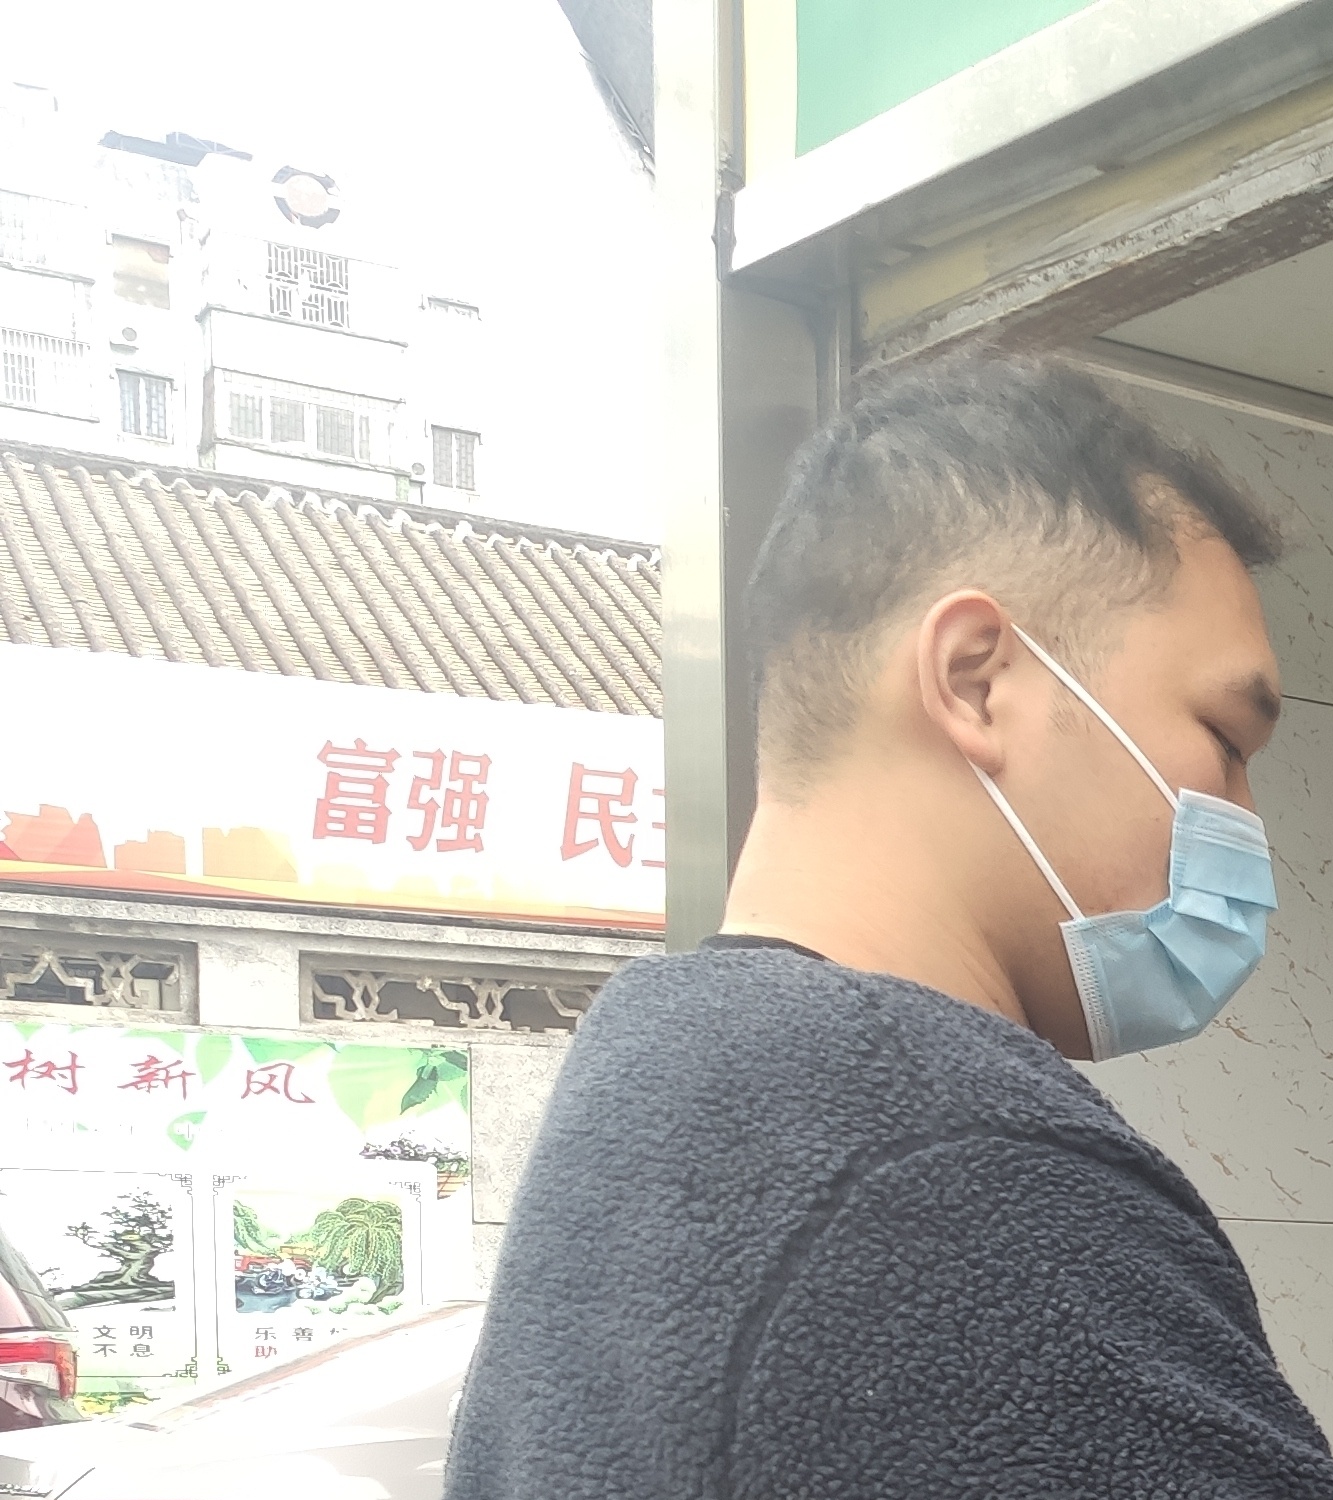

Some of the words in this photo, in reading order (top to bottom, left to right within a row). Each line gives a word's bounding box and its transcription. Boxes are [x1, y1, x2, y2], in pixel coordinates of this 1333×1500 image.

[312, 737, 493, 854] 富强
[2, 1048, 316, 1104] 树新风
[92, 1325, 154, 1340] 文明
[254, 1326, 349, 1342] 乐善
[92, 1343, 154, 1358] 不息
